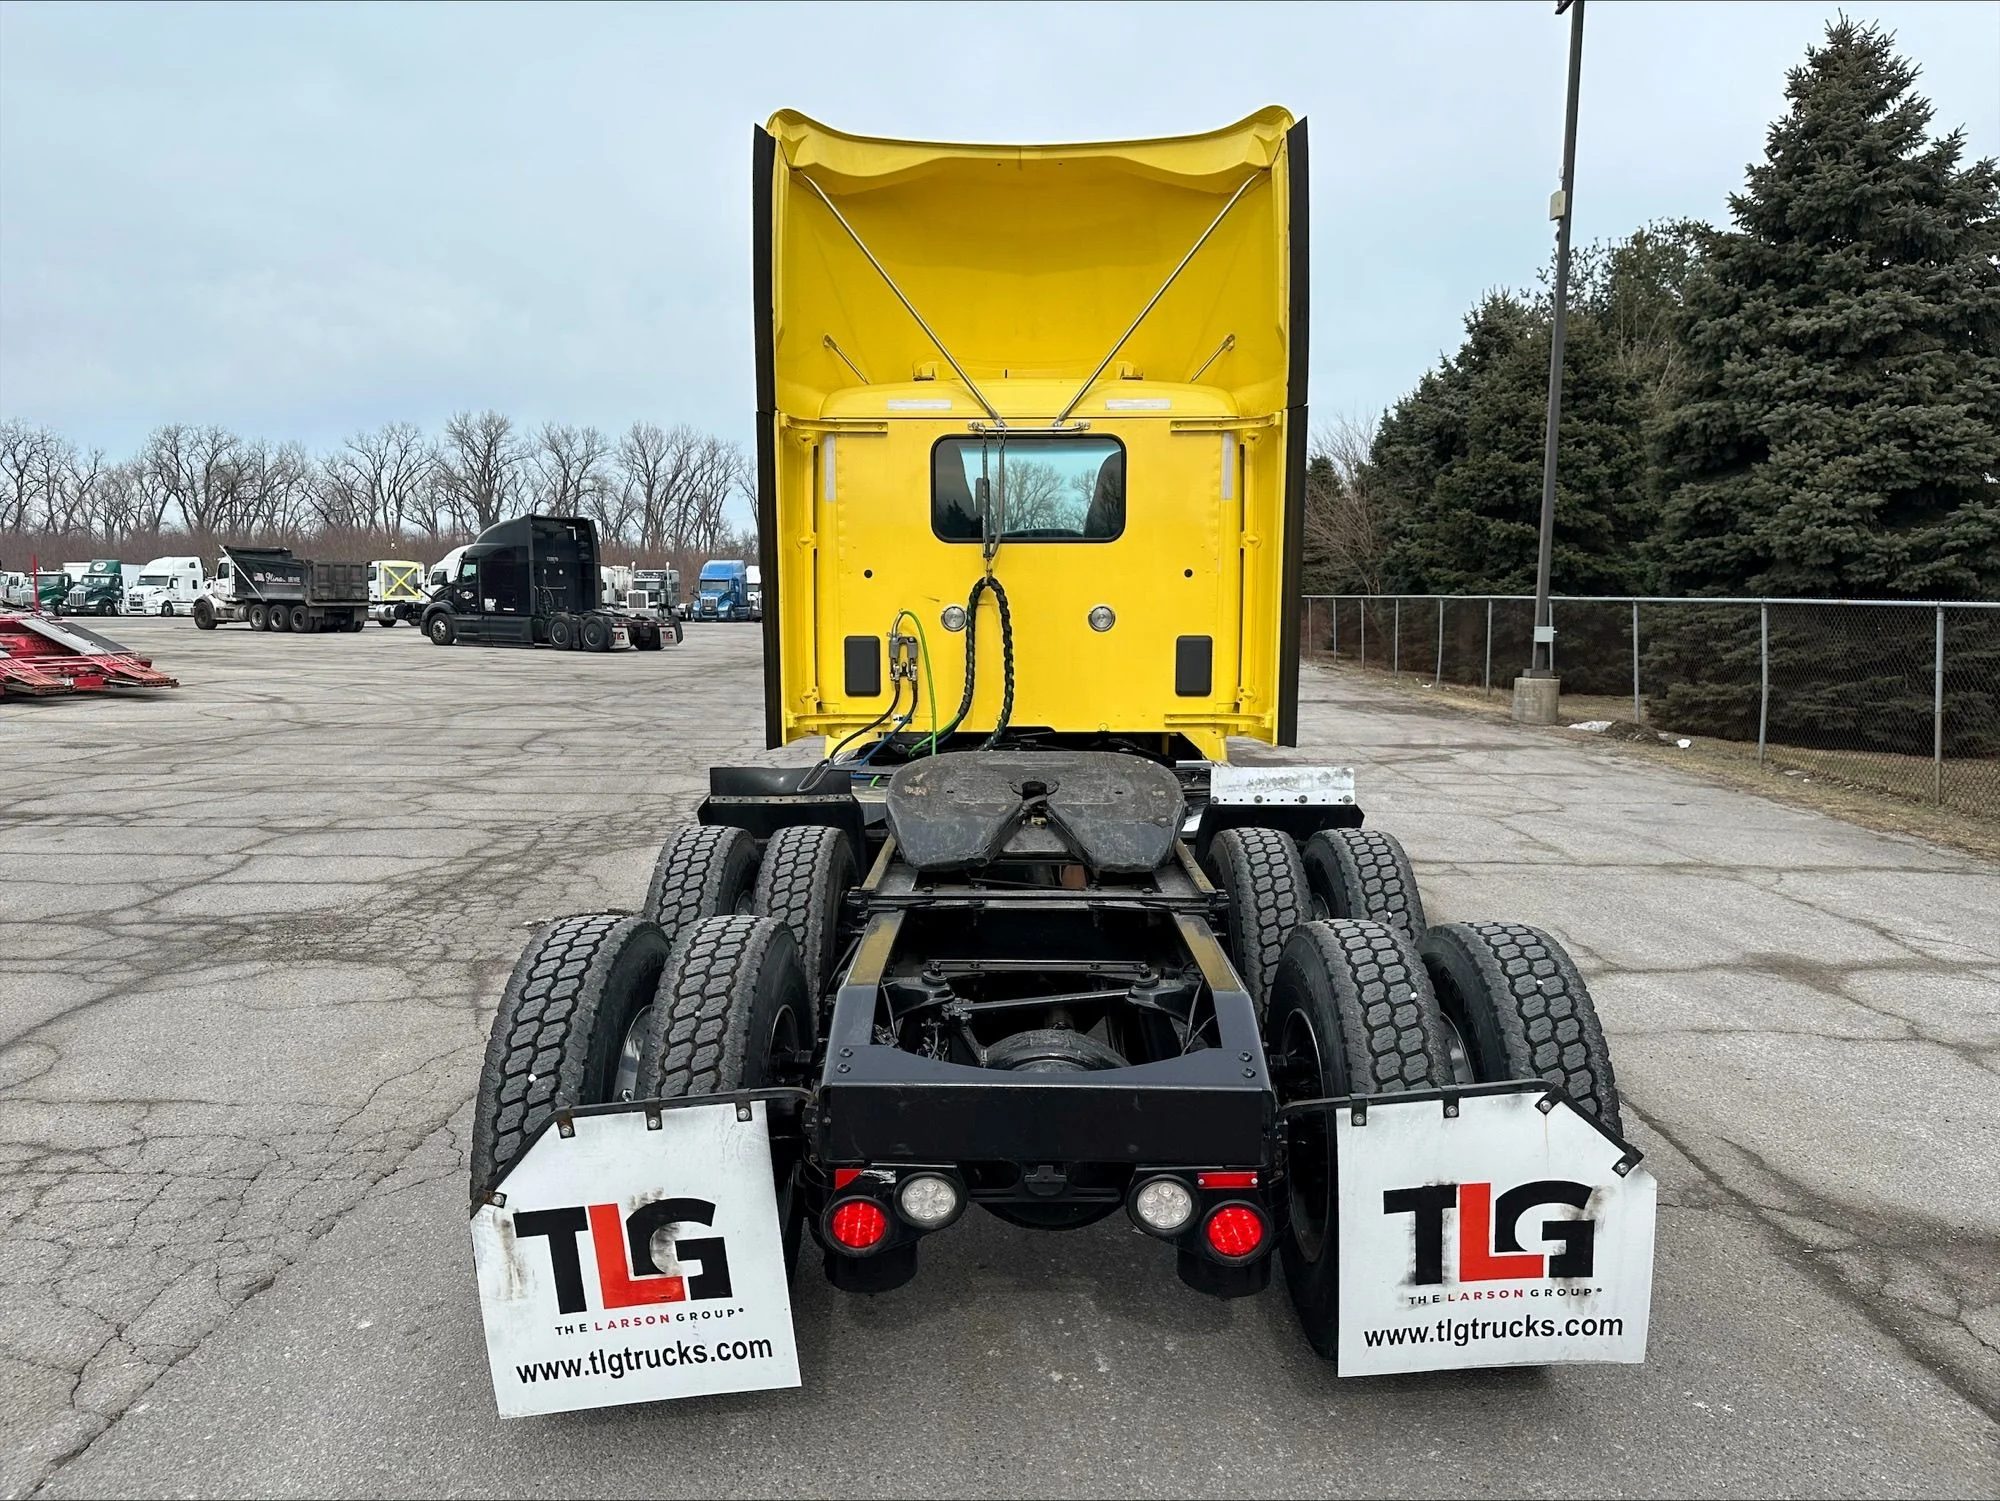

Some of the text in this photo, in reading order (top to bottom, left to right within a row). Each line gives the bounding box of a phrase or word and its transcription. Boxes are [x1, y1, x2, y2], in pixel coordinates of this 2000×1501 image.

[1383, 1180, 1595, 1286] TLG
[512, 1197, 733, 1315] TLG
[1408, 1294, 1440, 1305] THE
[1447, 1288, 1524, 1302] LARSON
[555, 1322, 588, 1336] THE
[595, 1313, 670, 1331] LARSON
[1364, 1314, 1624, 1347] www.tlgtrucks.com
[516, 1338, 773, 1384] www.tlgtrucks.com
